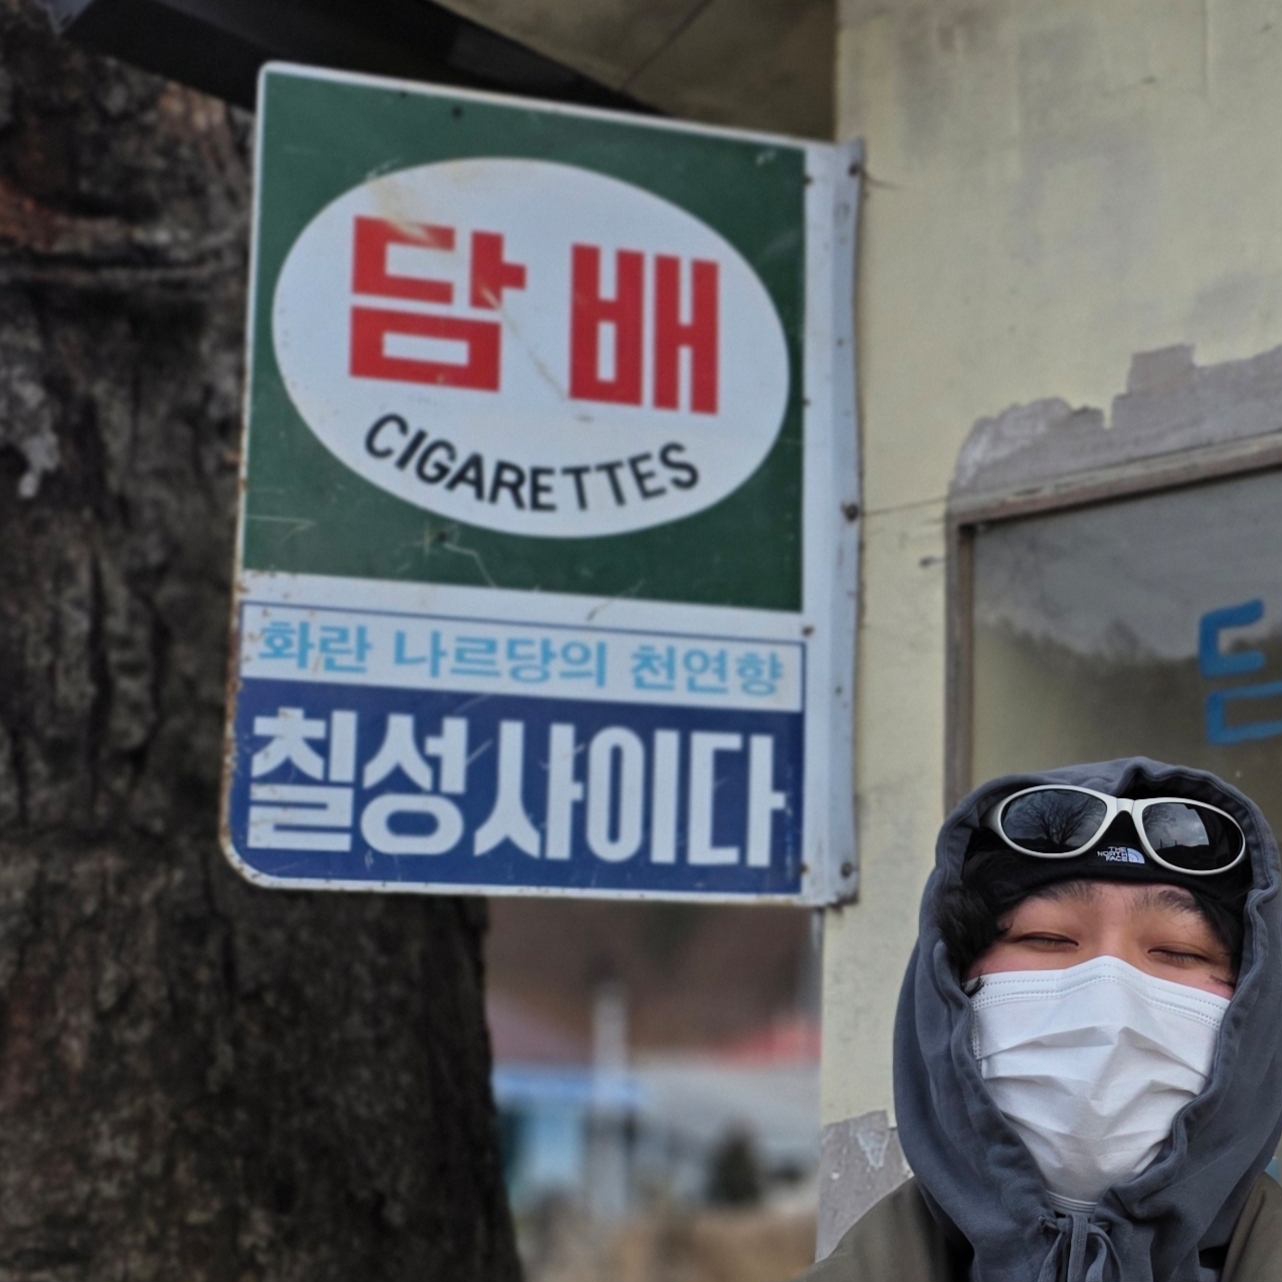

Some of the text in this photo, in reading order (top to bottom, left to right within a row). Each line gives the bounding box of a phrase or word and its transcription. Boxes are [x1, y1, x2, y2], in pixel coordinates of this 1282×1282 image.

[363, 412, 701, 513] CIGARETTES
[257, 620, 784, 699] 화란 나르당의 천연향
[246, 705, 787, 868] 칠성사이다
